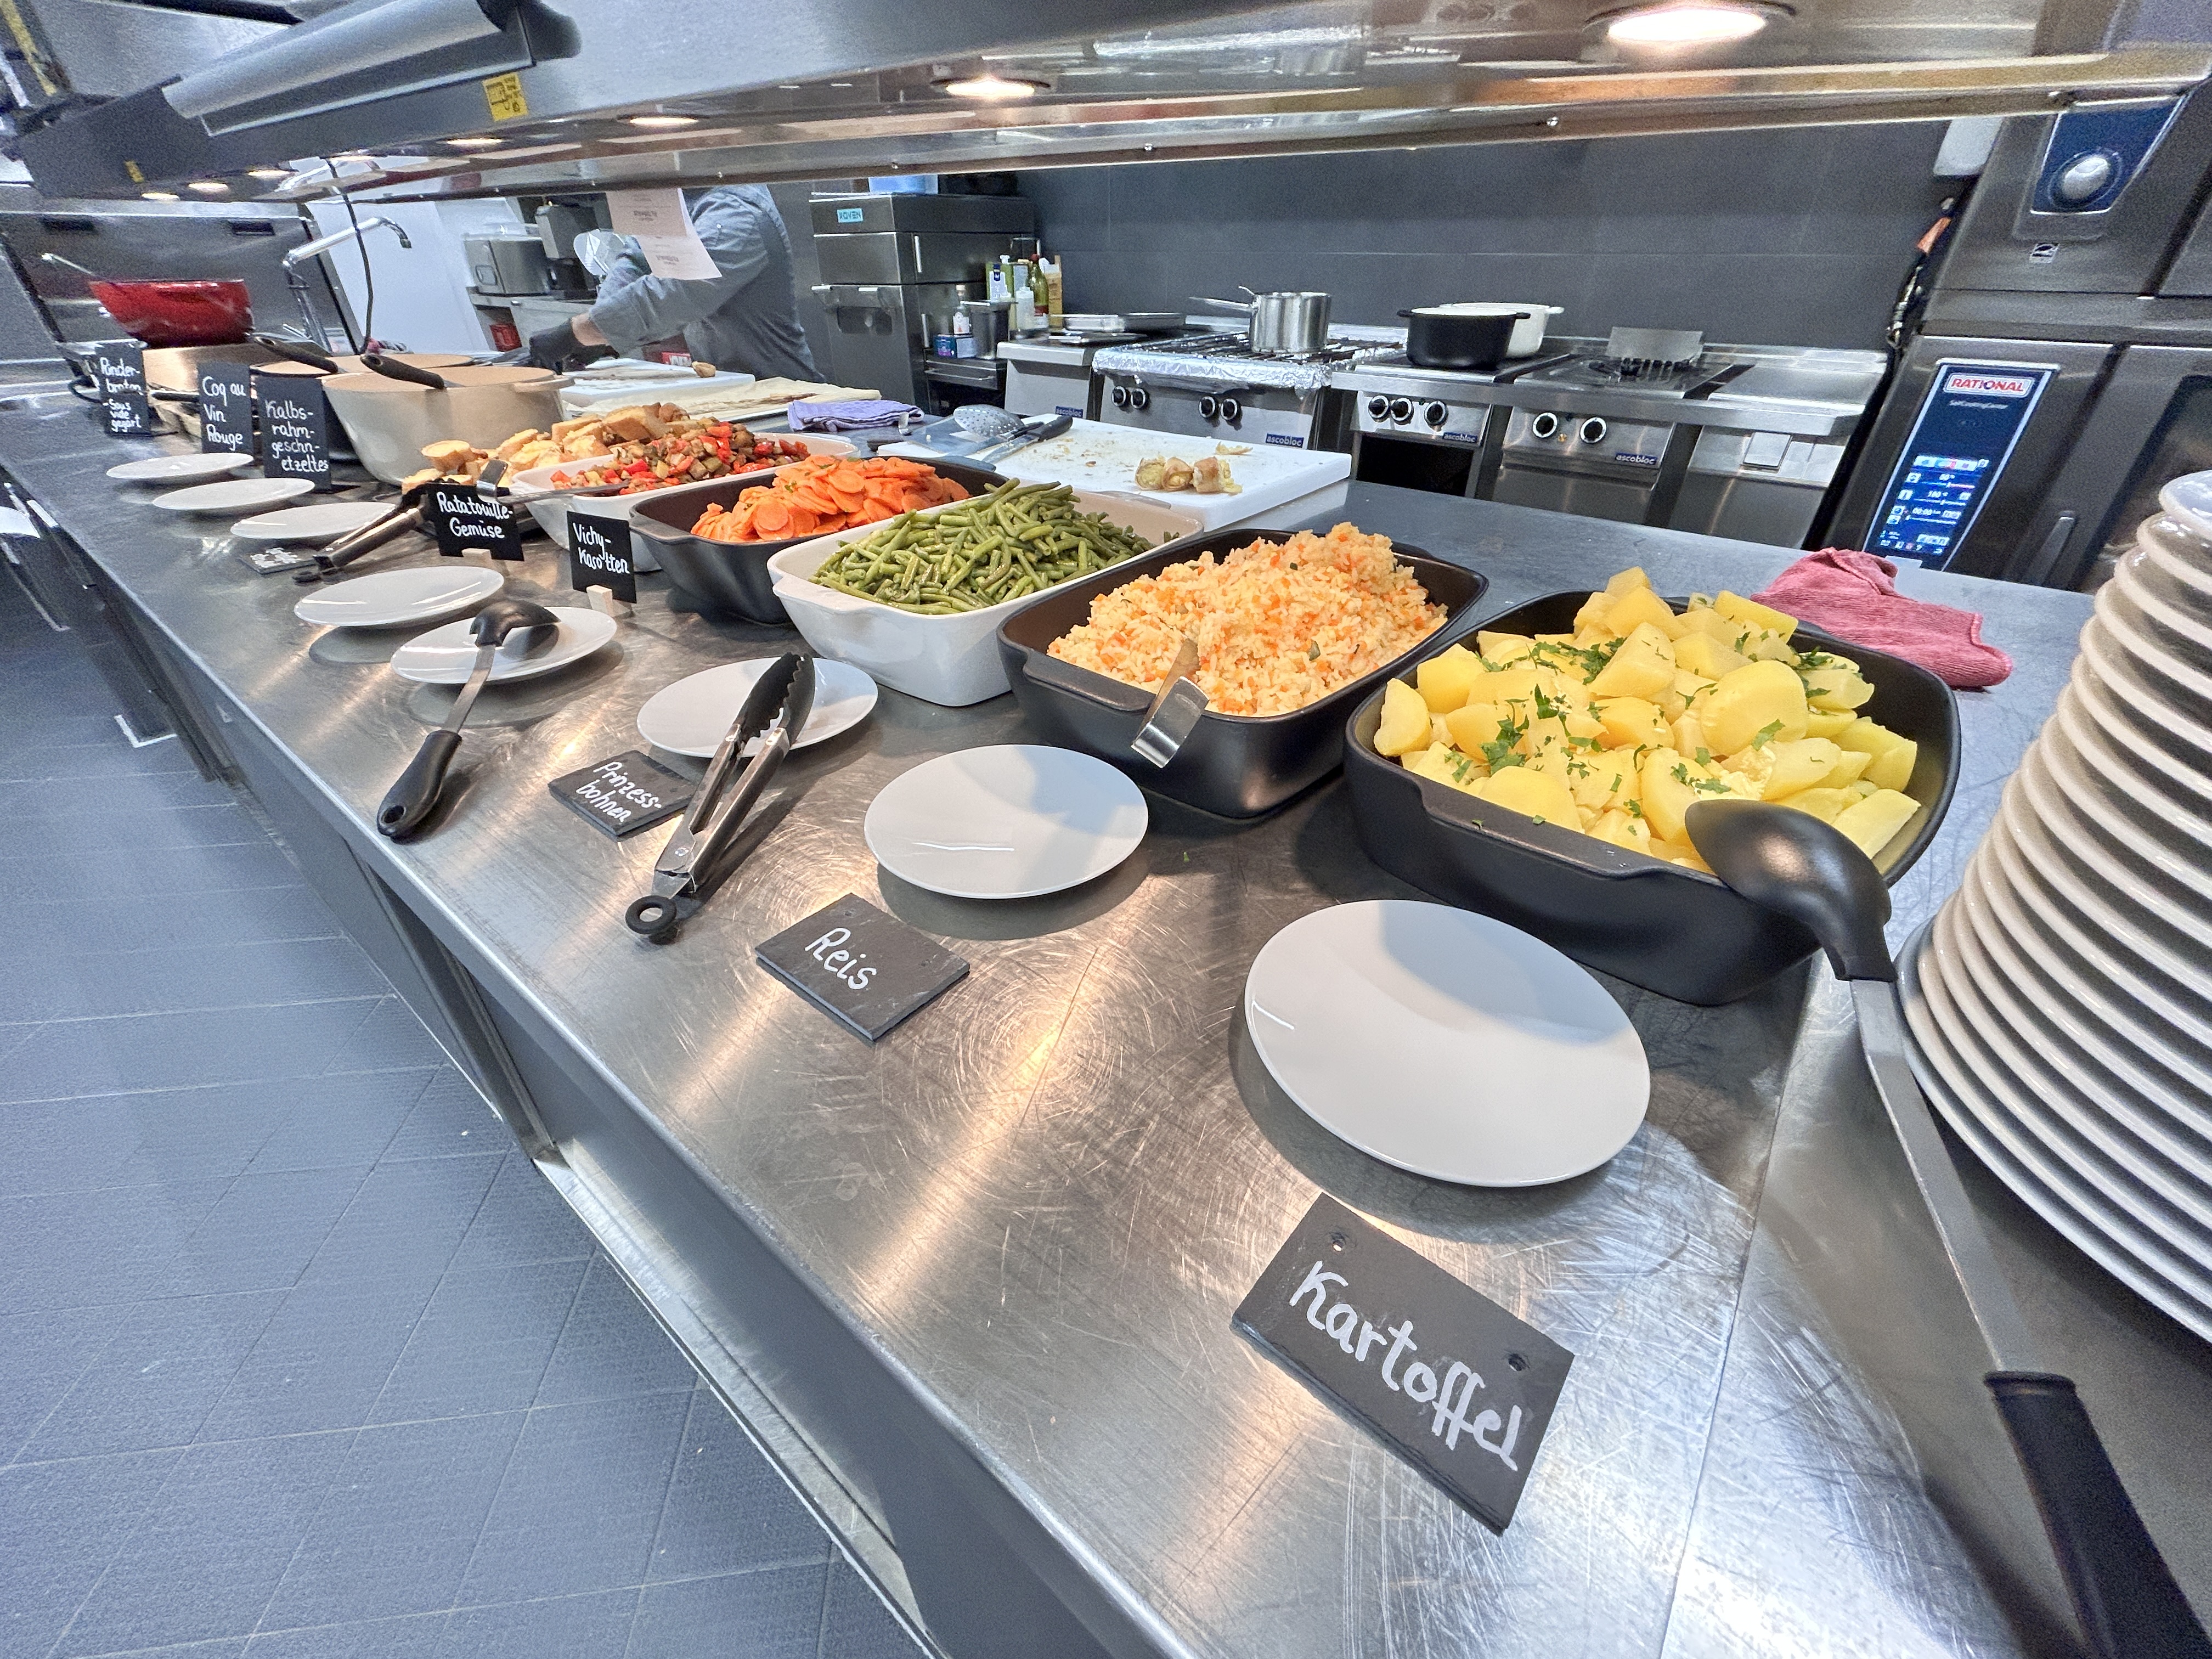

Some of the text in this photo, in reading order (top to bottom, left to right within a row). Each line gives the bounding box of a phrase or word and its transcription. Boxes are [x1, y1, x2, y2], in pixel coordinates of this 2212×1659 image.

[202, 376, 246, 407] Coq au
[1951, 378, 2023, 392] RATIONAL
[204, 403, 226, 422] Vin
[265, 399, 314, 420] Kalbs-
[206, 424, 243, 451] Rouge
[271, 421, 315, 438] rahm-
[1267, 436, 1302, 447] ascobloc
[1444, 434, 1476, 442] ascobloc
[1616, 455, 1655, 464] ascobloc
[436, 492, 513, 520] Ratatouille-
[449, 517, 505, 539] Gemüse
[573, 522, 612, 561] Vichy-
[593, 761, 662, 808] Prinzess-
[576, 779, 631, 822] bohnen
[805, 927, 877, 989] Reis
[1289, 1260, 1522, 1471] Kartoffel
